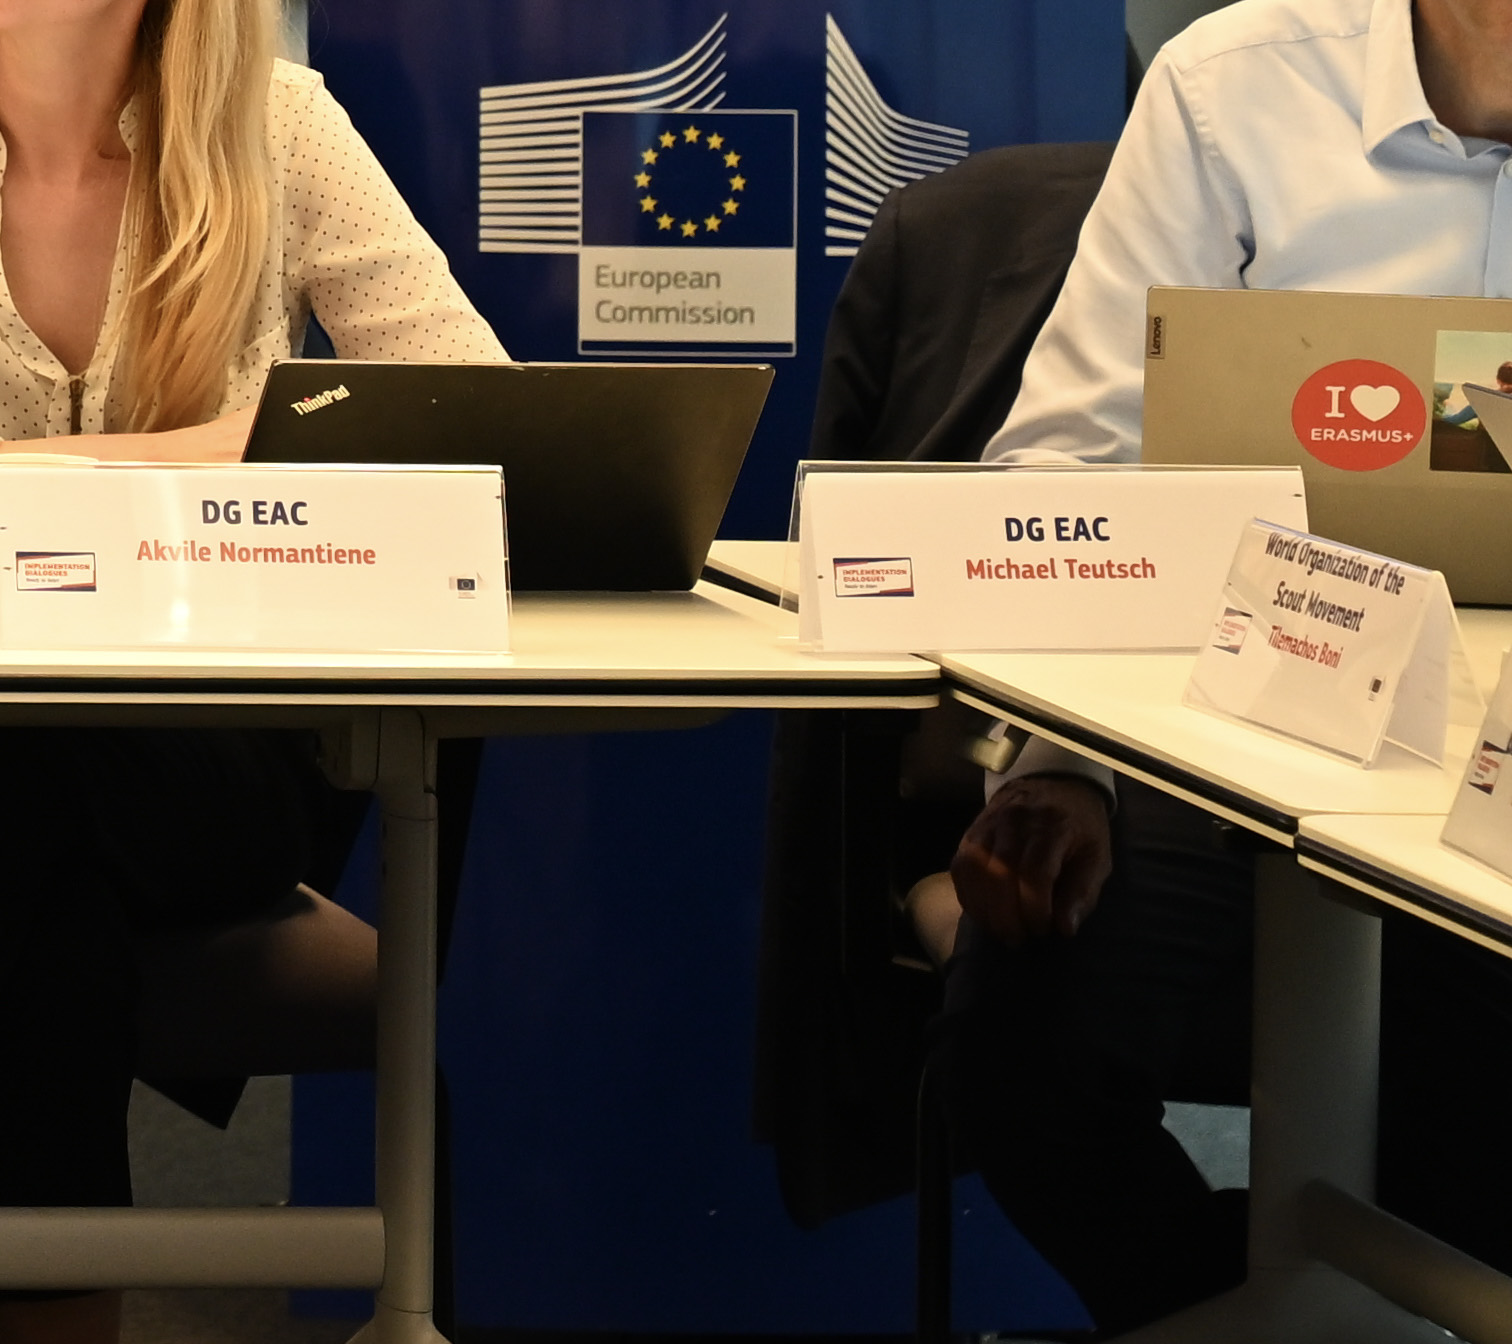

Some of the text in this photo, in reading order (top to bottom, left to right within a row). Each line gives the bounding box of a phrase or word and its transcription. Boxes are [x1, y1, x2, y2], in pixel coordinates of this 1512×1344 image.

[595, 264, 721, 294] European
[595, 299, 755, 325] Commission
[1150, 316, 1162, 355] Lenovo
[290, 384, 351, 416] ThinkPad
[1325, 386, 1345, 418] I
[1311, 428, 1414, 443] ERASMUS+
[202, 500, 309, 525] DG EAC
[1004, 516, 1111, 541] DG EAC
[137, 539, 376, 565] Akvile Normantiene
[1265, 532, 1405, 595] World Organization of the
[966, 557, 1156, 580] Michael Teutsch
[1272, 580, 1365, 632] Scout Movement
[1267, 625, 1319, 662] Tilemachos
[1318, 640, 1345, 670] Boni
